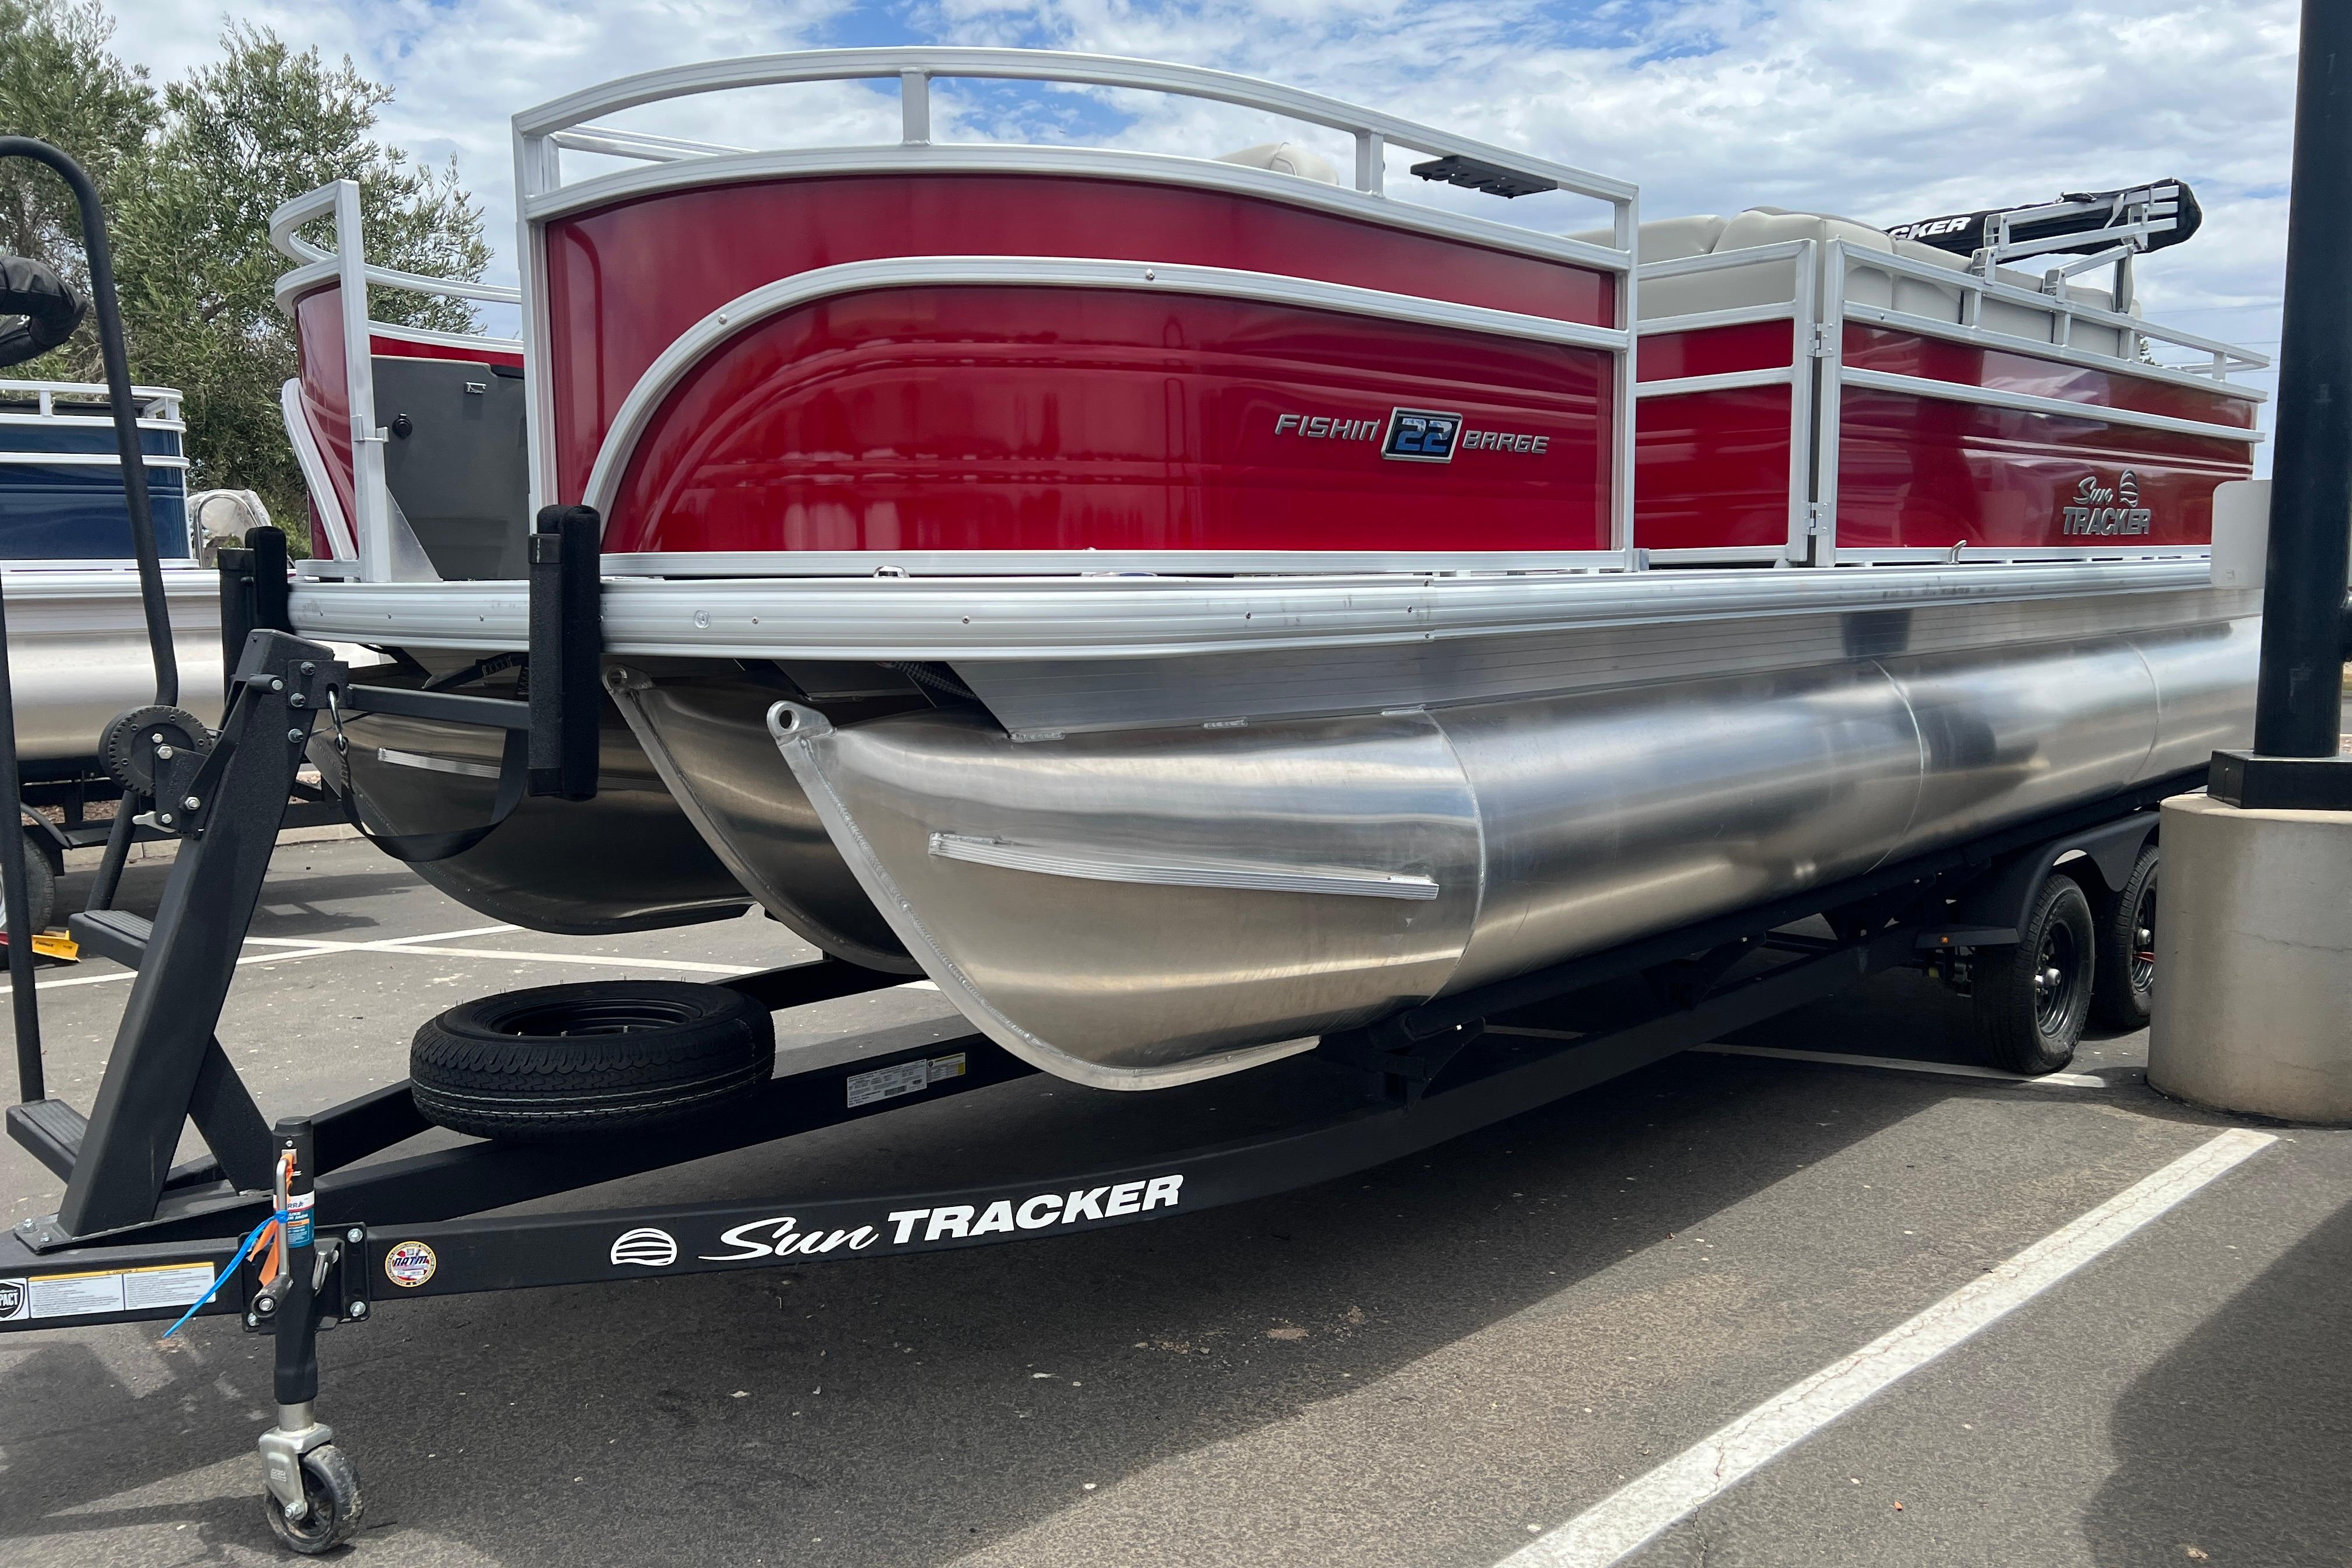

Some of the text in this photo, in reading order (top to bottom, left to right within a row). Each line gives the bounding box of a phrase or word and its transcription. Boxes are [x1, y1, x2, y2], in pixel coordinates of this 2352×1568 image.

[1395, 417, 1453, 453] 22
[1462, 429, 1550, 454] BARGE
[2073, 476, 2113, 505] Sun
[2063, 506, 2151, 536] TRACKER
[698, 1174, 1184, 1261] Sun TRACKER
